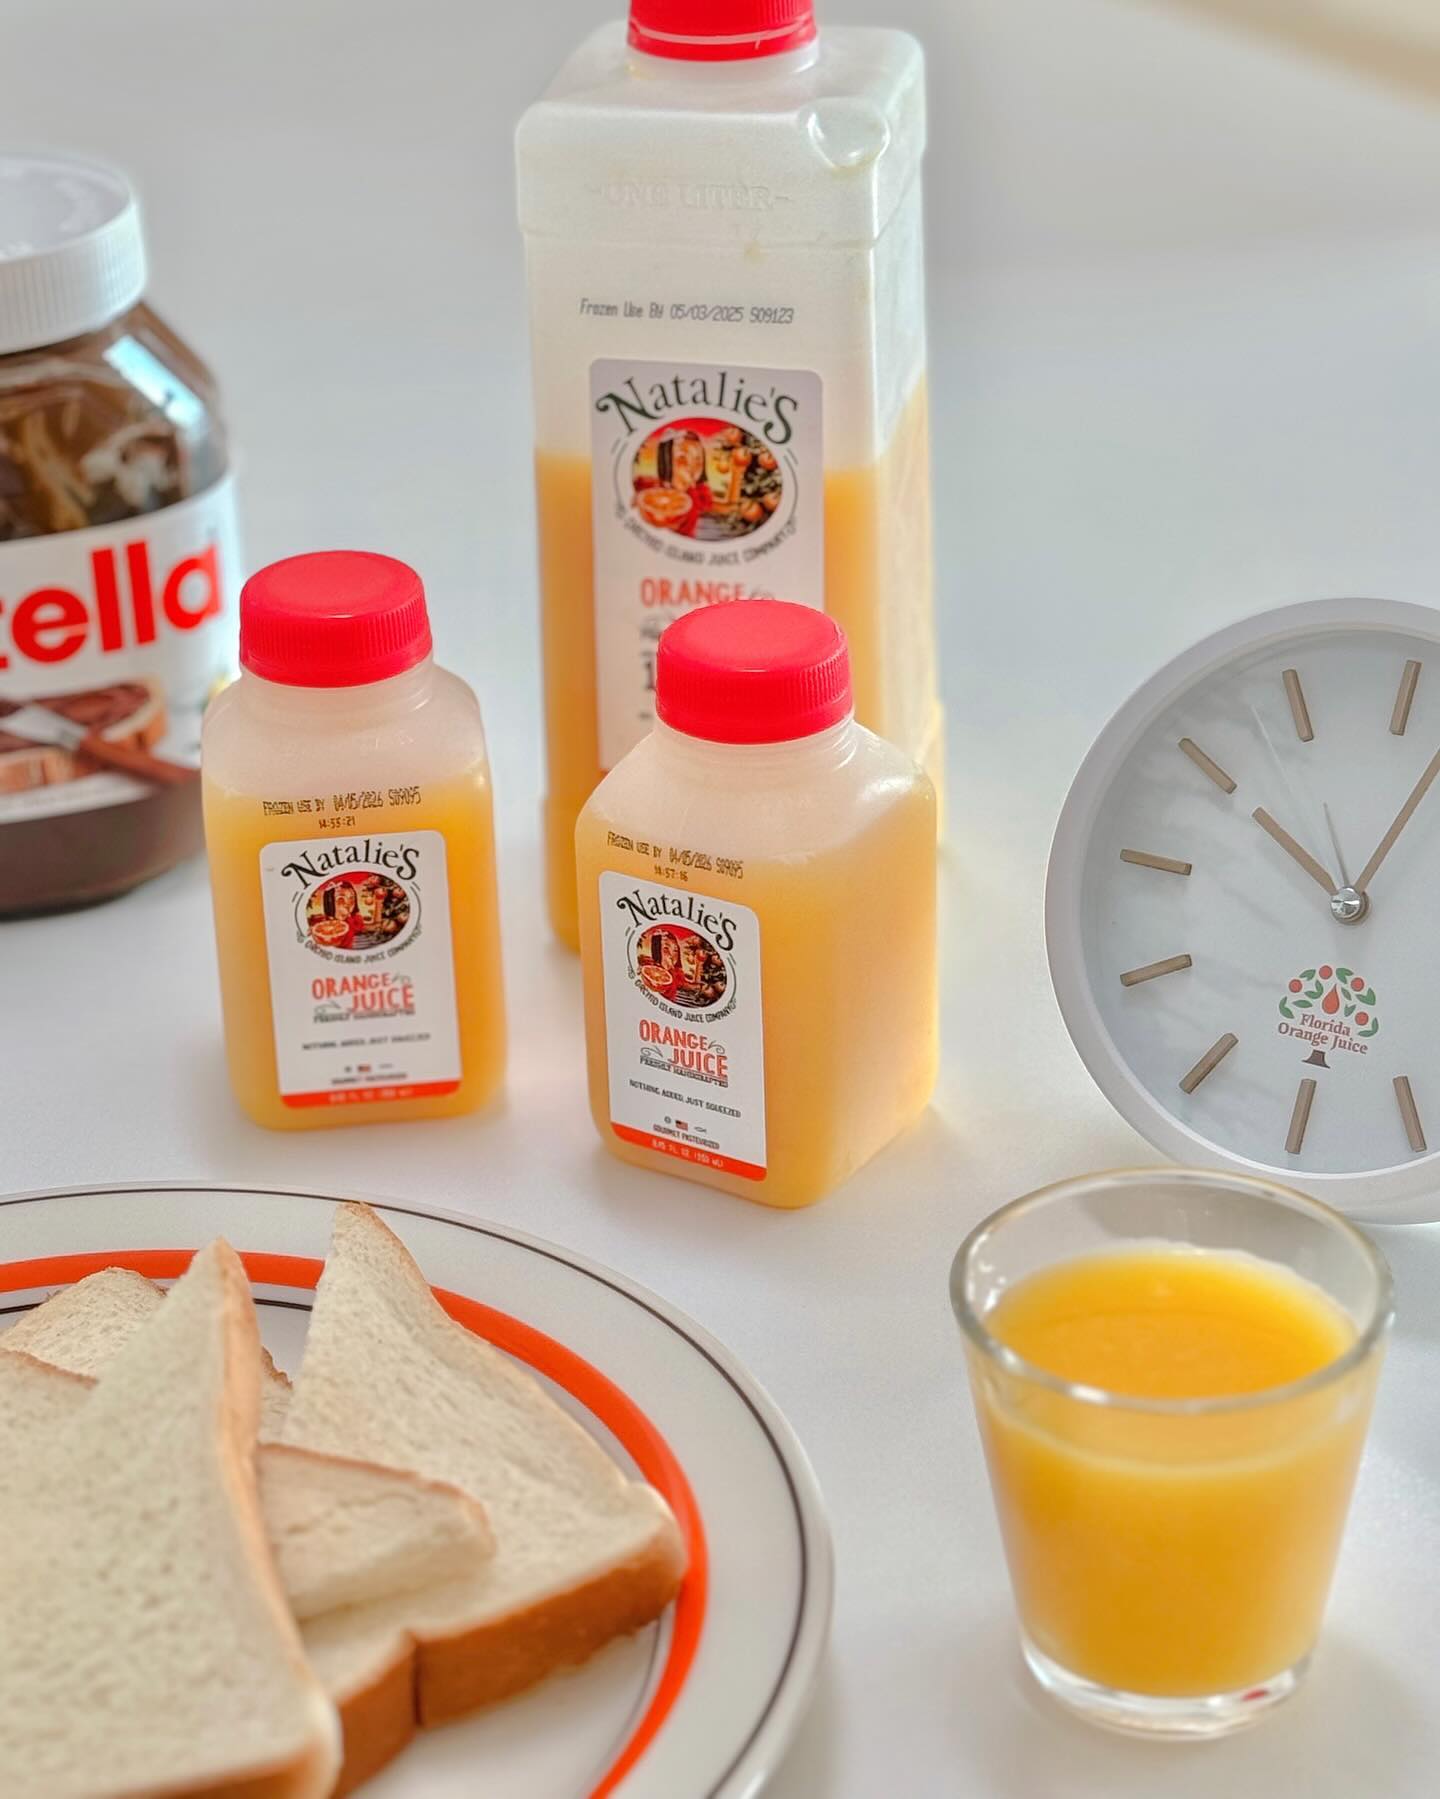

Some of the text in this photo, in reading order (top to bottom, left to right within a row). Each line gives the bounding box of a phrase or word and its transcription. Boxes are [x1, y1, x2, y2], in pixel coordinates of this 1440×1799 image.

[580, 297, 618, 316] Frozen
[623, 300, 643, 318] Use
[670, 303, 744, 322] 05/03/2025
[640, 577, 743, 608] ORANGE
[312, 972, 391, 1000] ORANGE
[347, 983, 414, 1014] JUICE
[684, 1012, 705, 1023] JUICE
[1300, 1013, 1352, 1037] Florida
[639, 1019, 708, 1052] ORANGE
[1278, 1022, 1368, 1055] Orange Juice
[667, 1047, 729, 1080] JUICE
[629, 1079, 661, 1096] NOTHING
[685, 1096, 704, 1109] JUST
[705, 1101, 741, 1118] SQUEEZED
